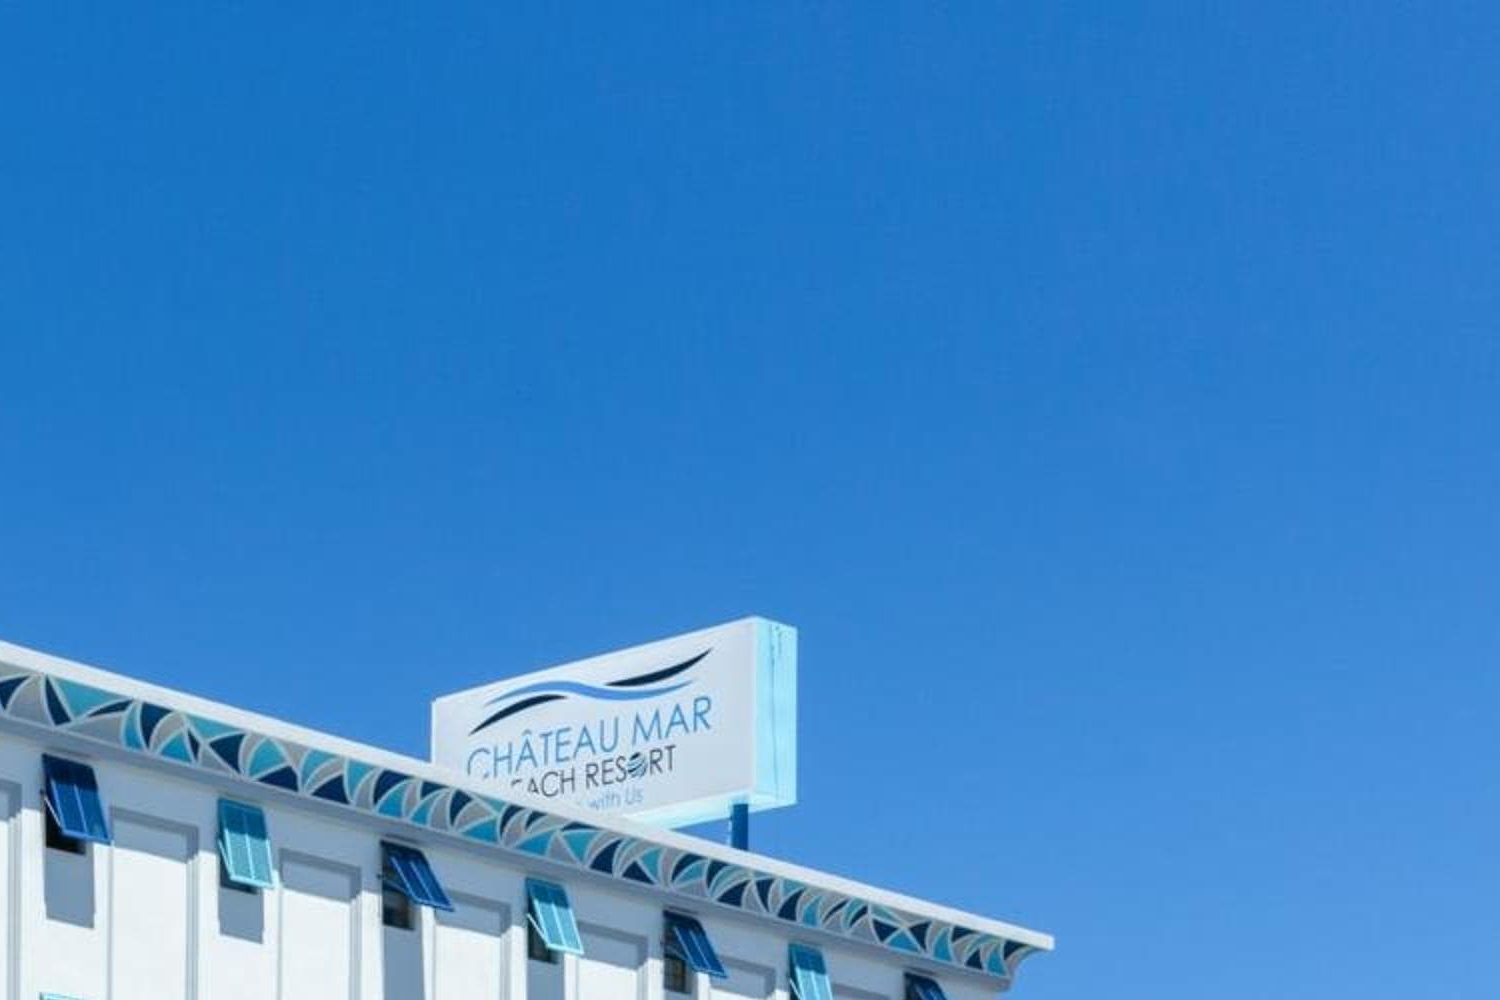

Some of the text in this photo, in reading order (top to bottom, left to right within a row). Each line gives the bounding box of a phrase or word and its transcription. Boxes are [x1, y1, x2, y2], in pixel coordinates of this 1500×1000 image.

[466, 697, 712, 778] CHÂTEAU MAR
[585, 745, 677, 788] RESORT
